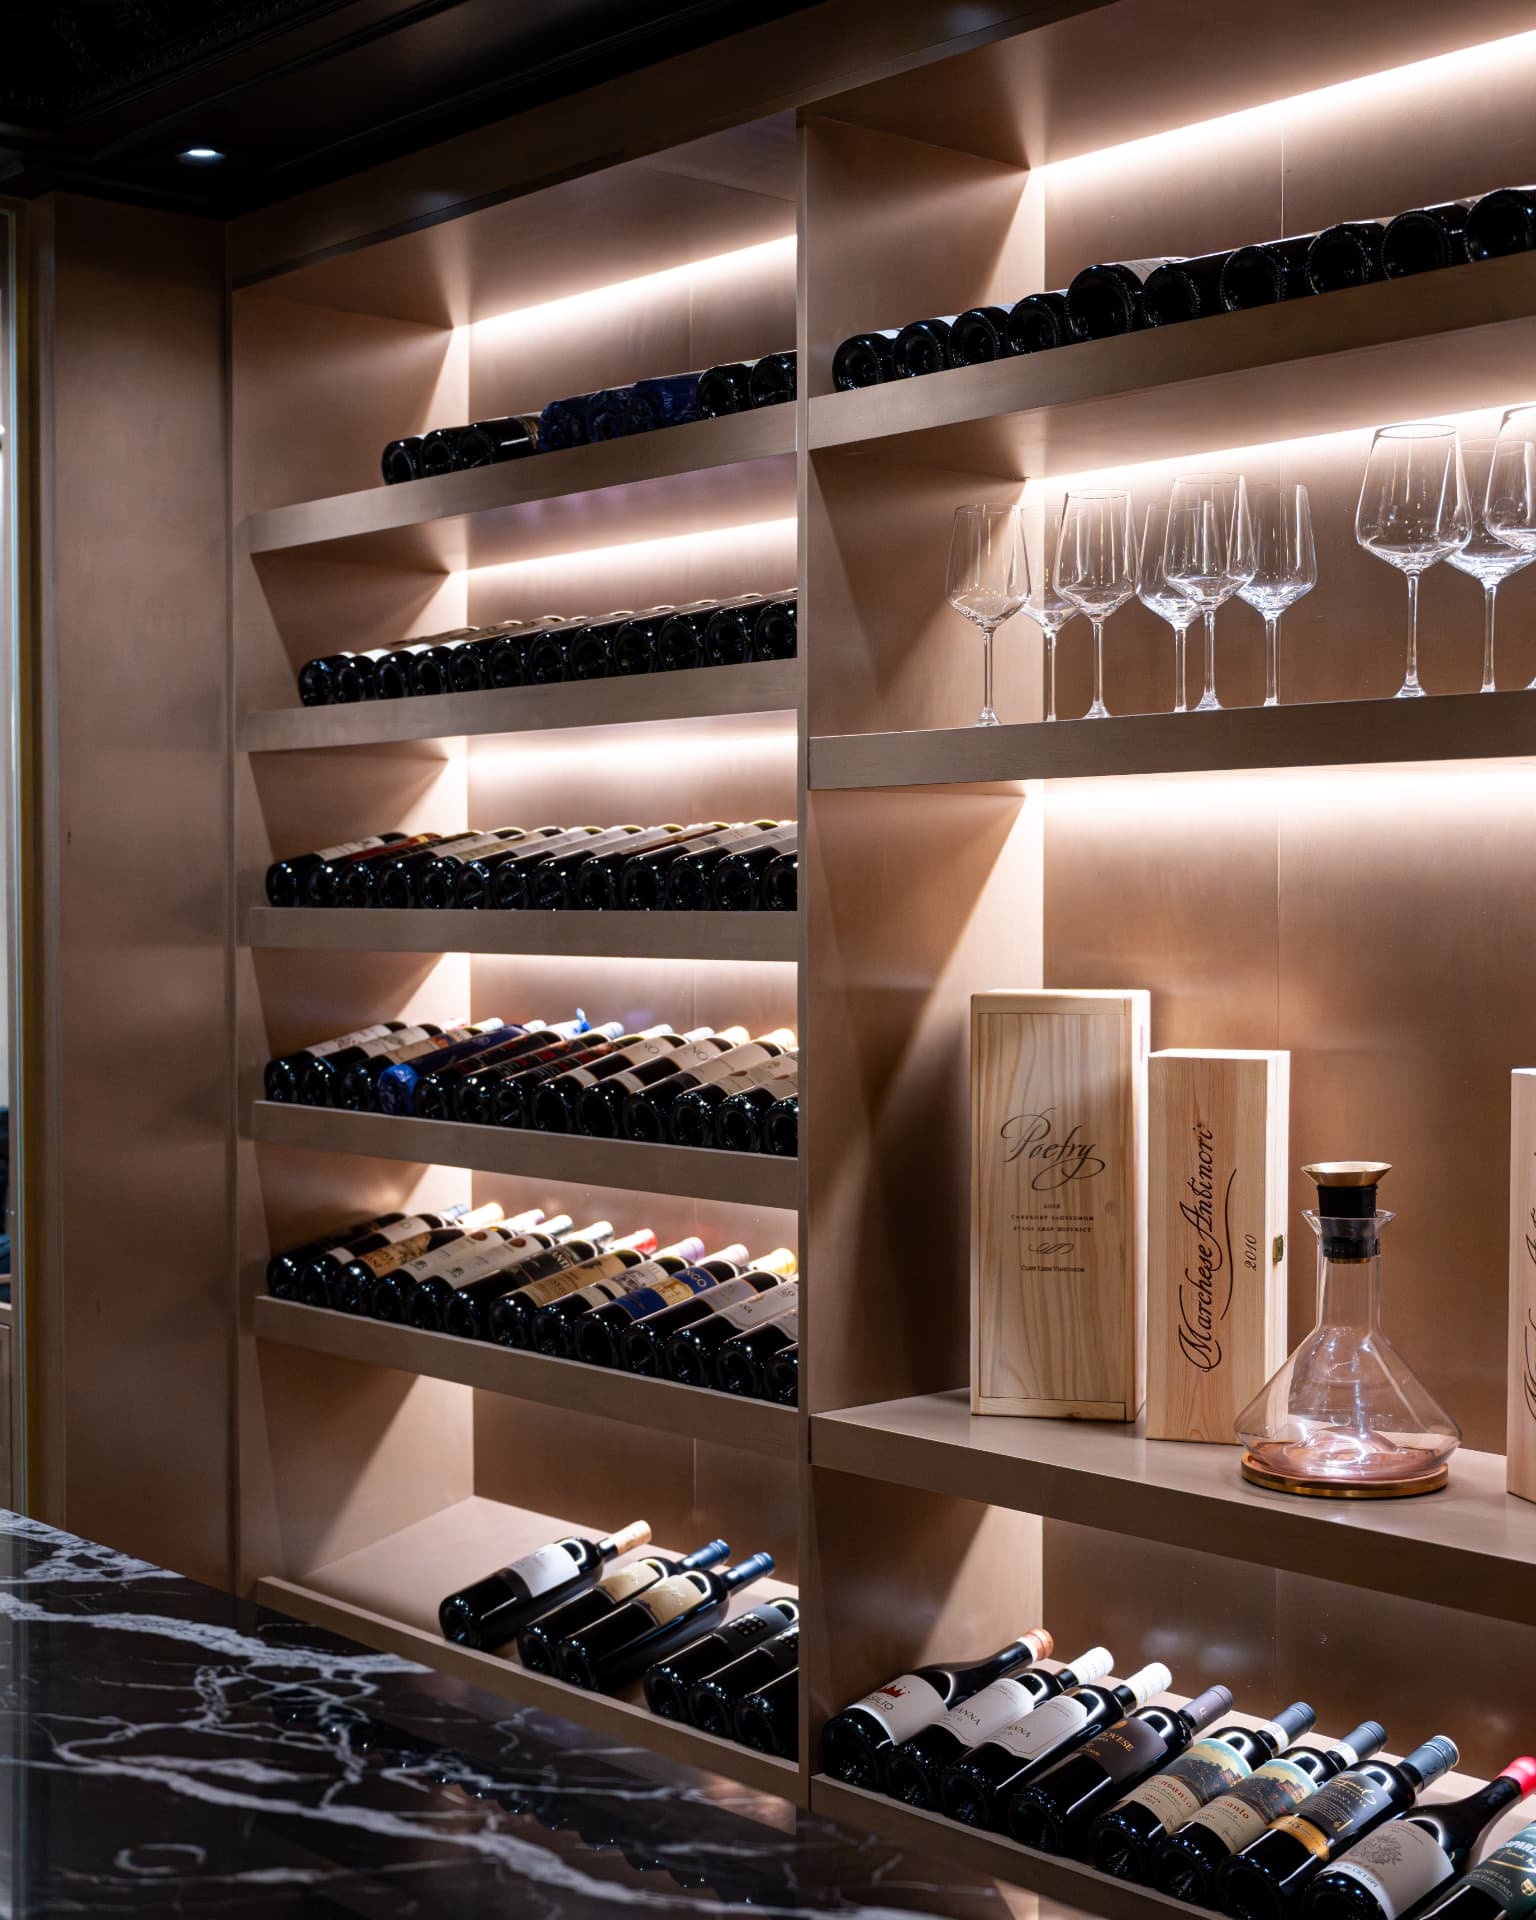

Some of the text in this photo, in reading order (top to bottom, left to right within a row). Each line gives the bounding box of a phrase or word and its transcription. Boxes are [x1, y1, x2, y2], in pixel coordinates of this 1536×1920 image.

[1000, 1107, 1106, 1191] Poetry
[1179, 1127, 1223, 1372] Marchese Antinori
[1244, 1234, 1257, 1272] 2010
